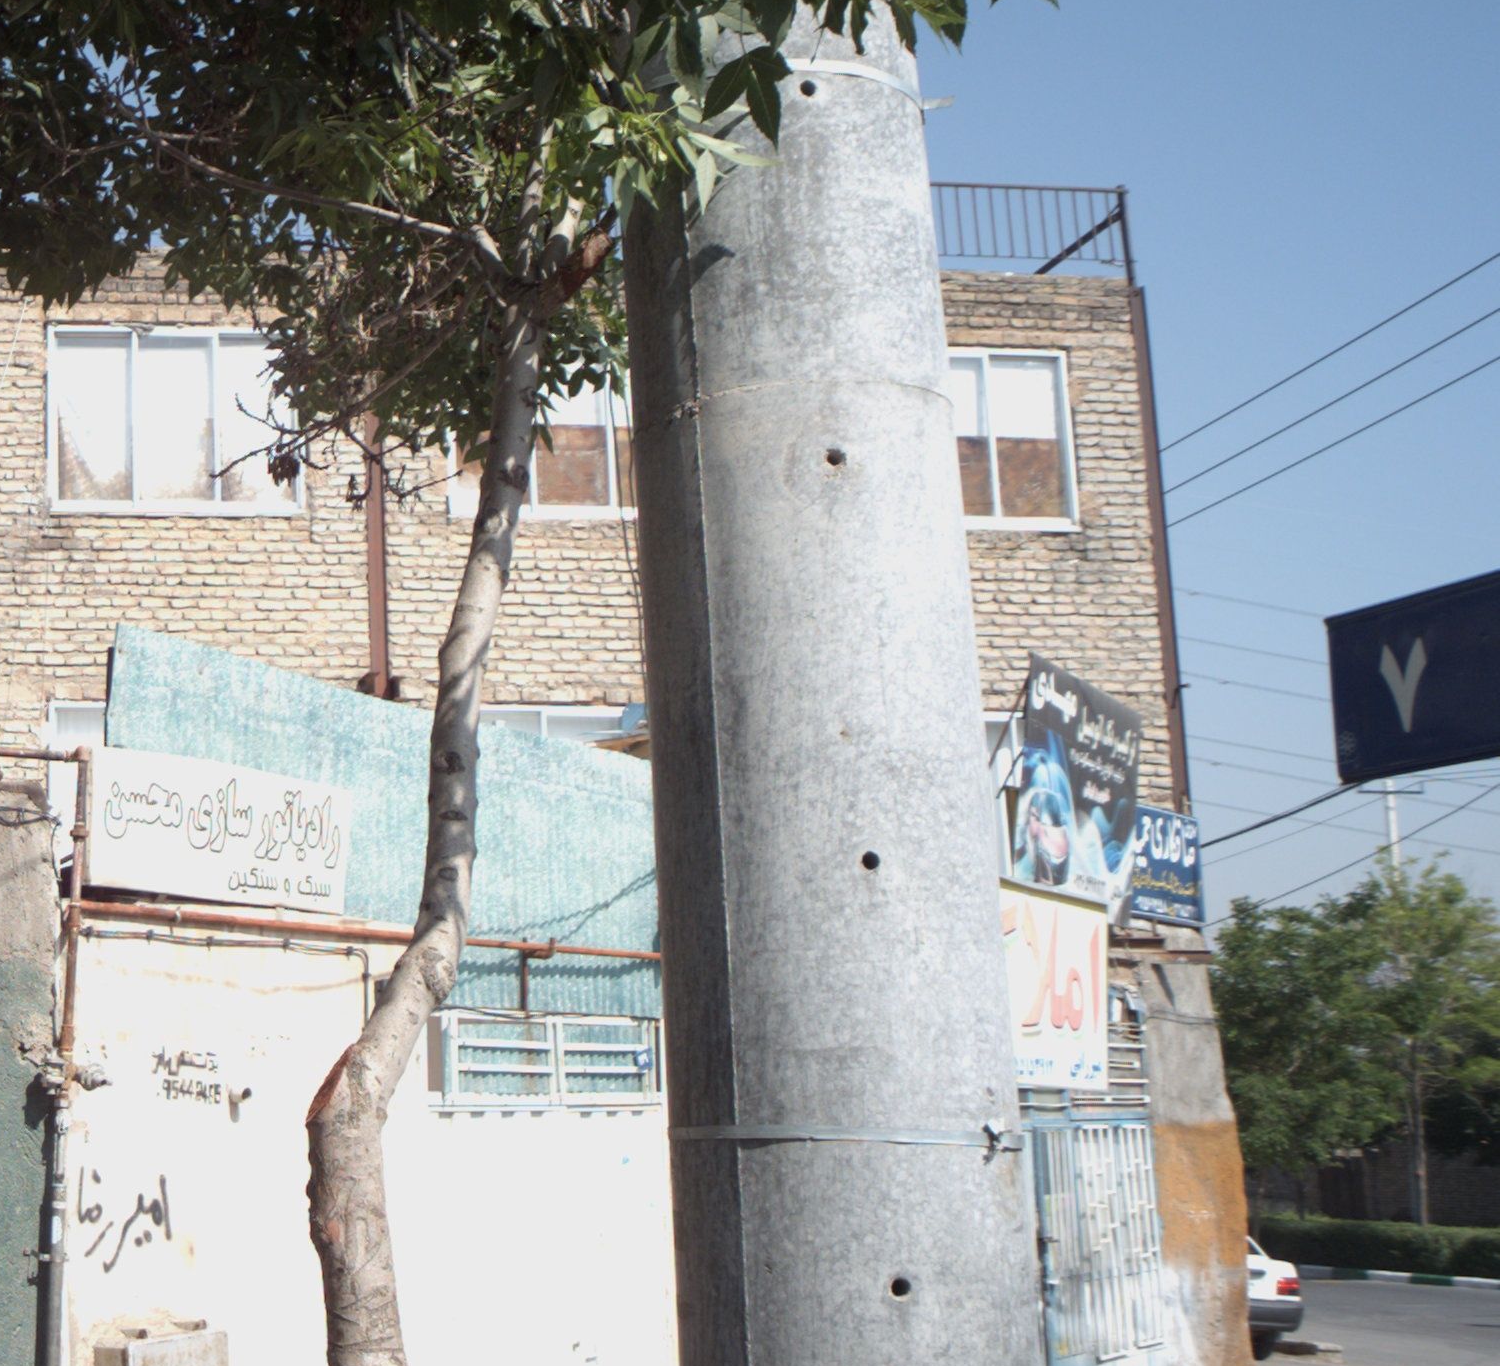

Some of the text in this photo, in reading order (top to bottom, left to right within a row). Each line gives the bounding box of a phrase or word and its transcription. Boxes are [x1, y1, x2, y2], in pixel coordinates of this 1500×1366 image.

[1379, 636, 1427, 734] ۷
[104, 778, 341, 869] رادیاتور سازی محسن
[297, 875, 332, 902] سبک
